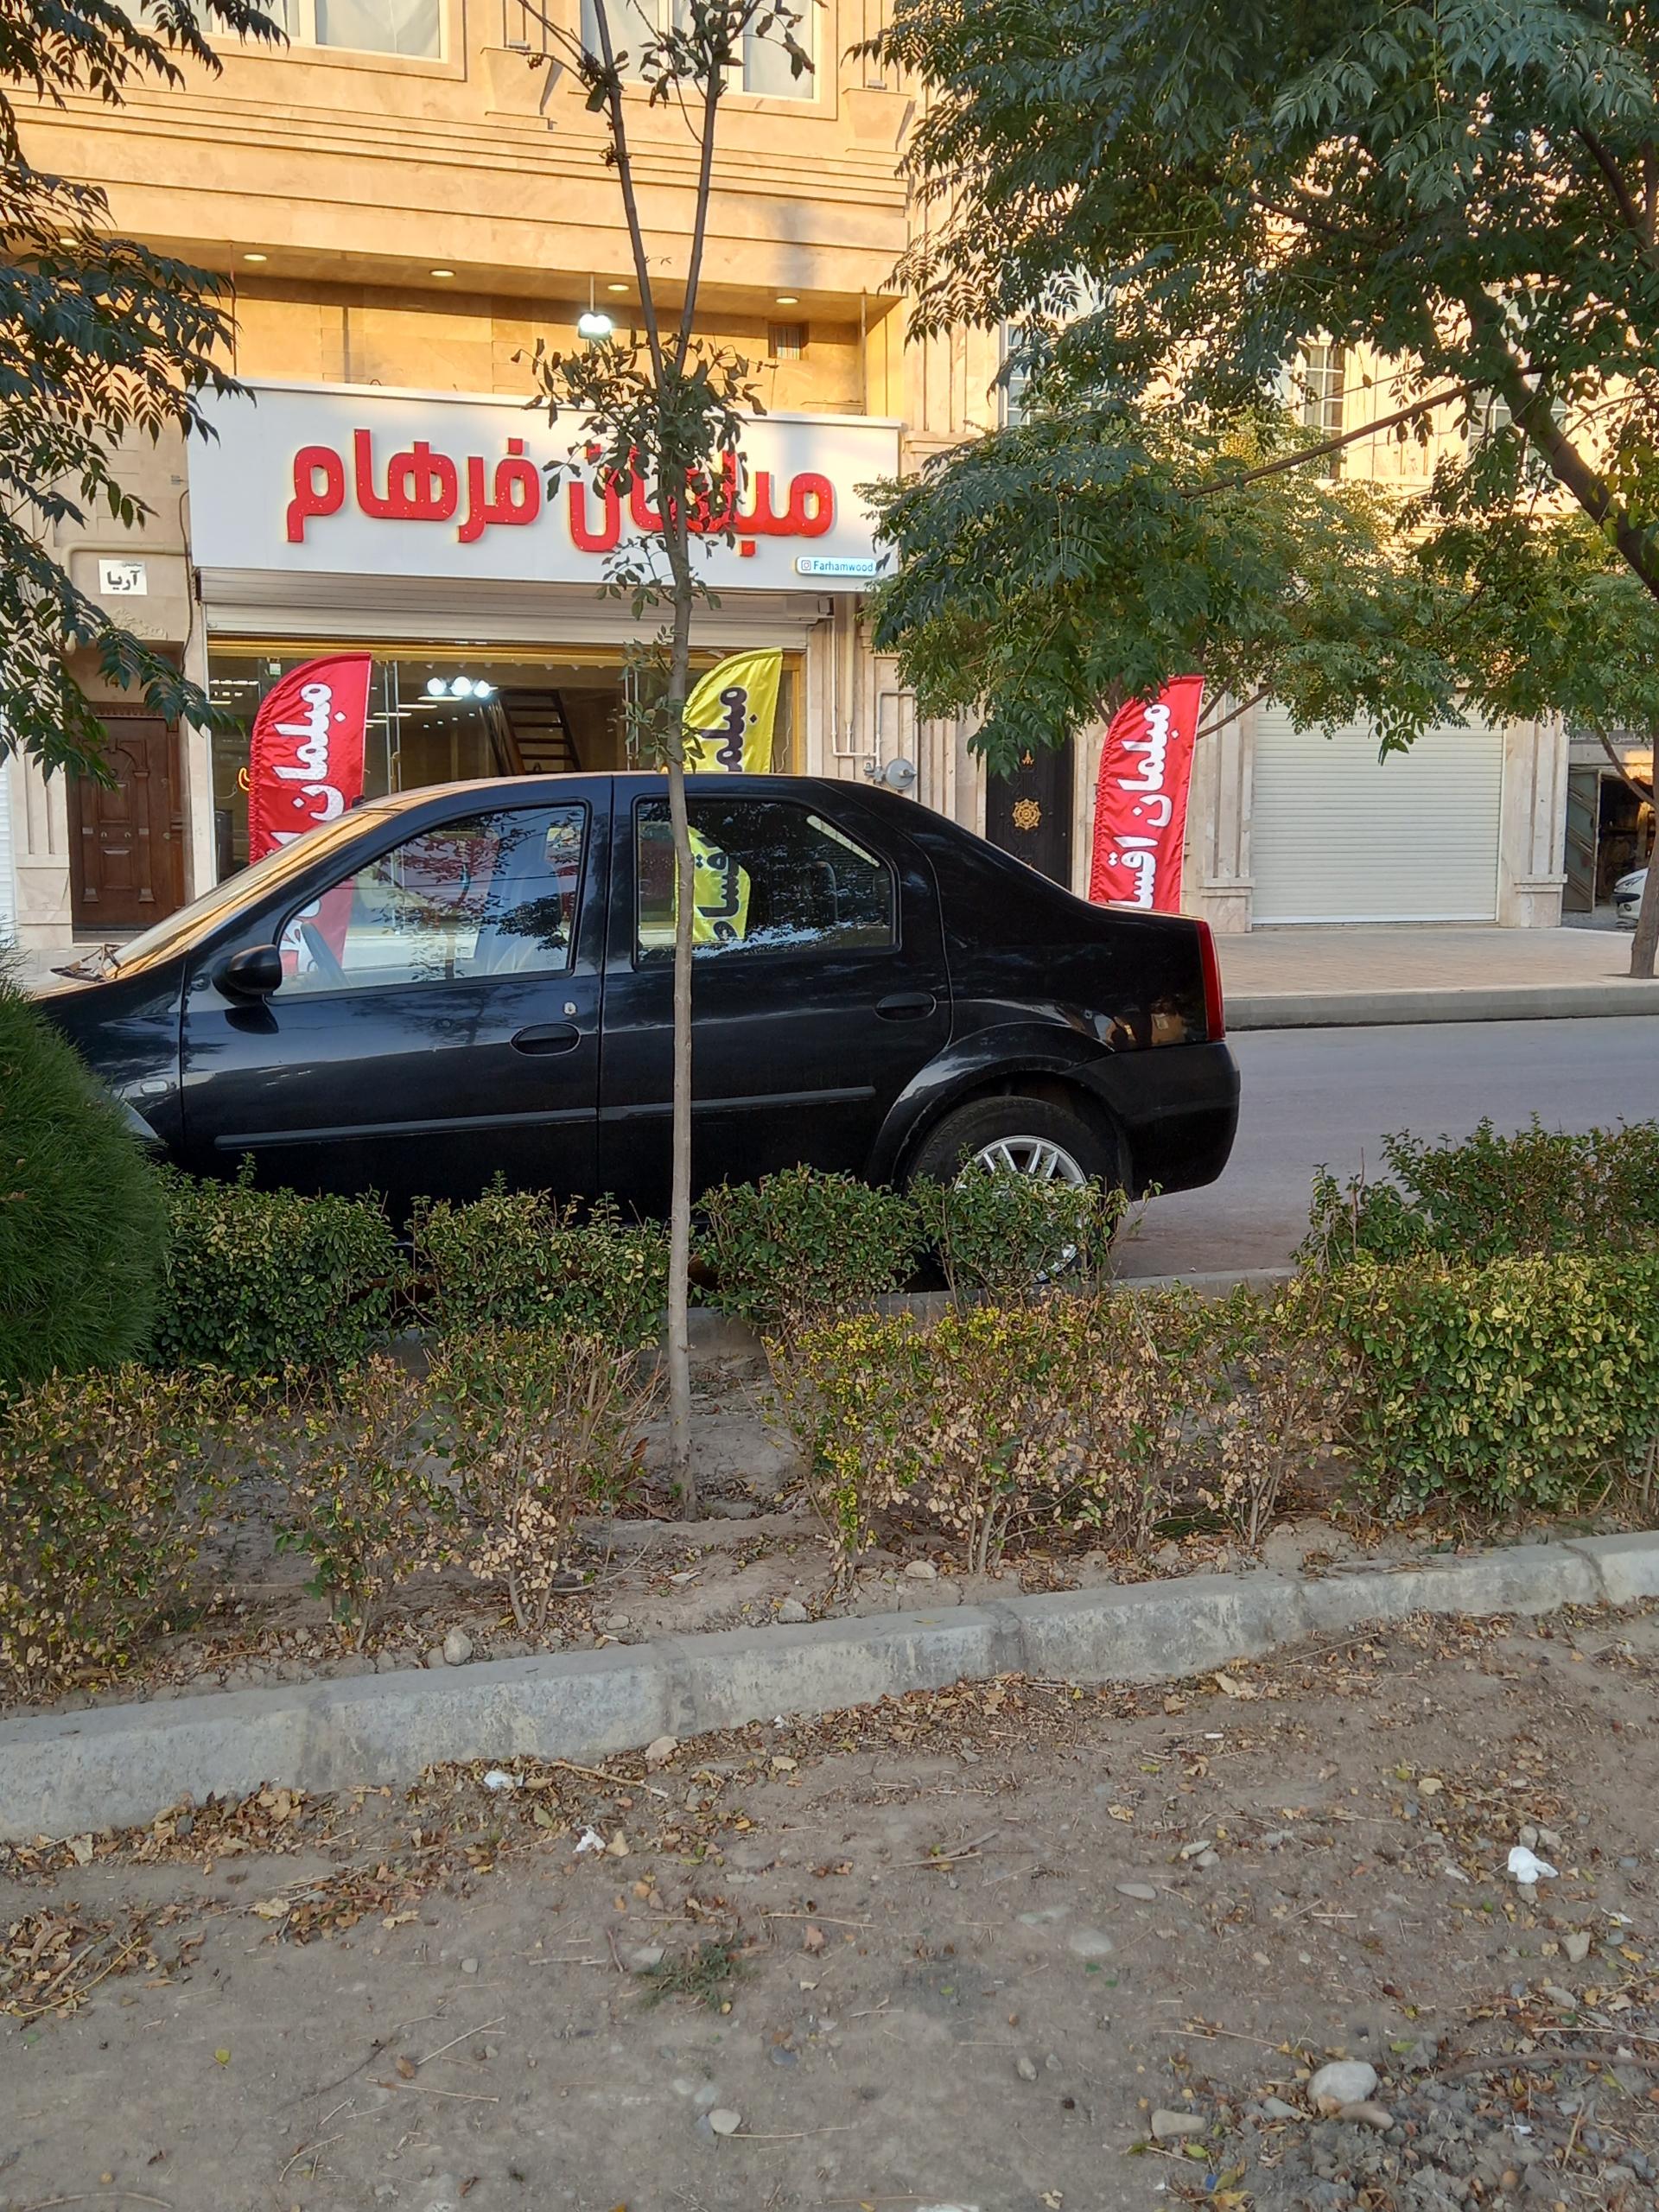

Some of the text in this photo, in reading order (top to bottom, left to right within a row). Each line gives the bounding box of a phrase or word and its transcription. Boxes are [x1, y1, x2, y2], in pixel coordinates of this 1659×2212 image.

[287, 429, 541, 543] فرهام
[813, 560, 874, 572] Farhamwood
[272, 682, 346, 822] مبلمان
[694, 686, 760, 772] مبلم
[1108, 703, 1179, 909] مبلمان اقسا
